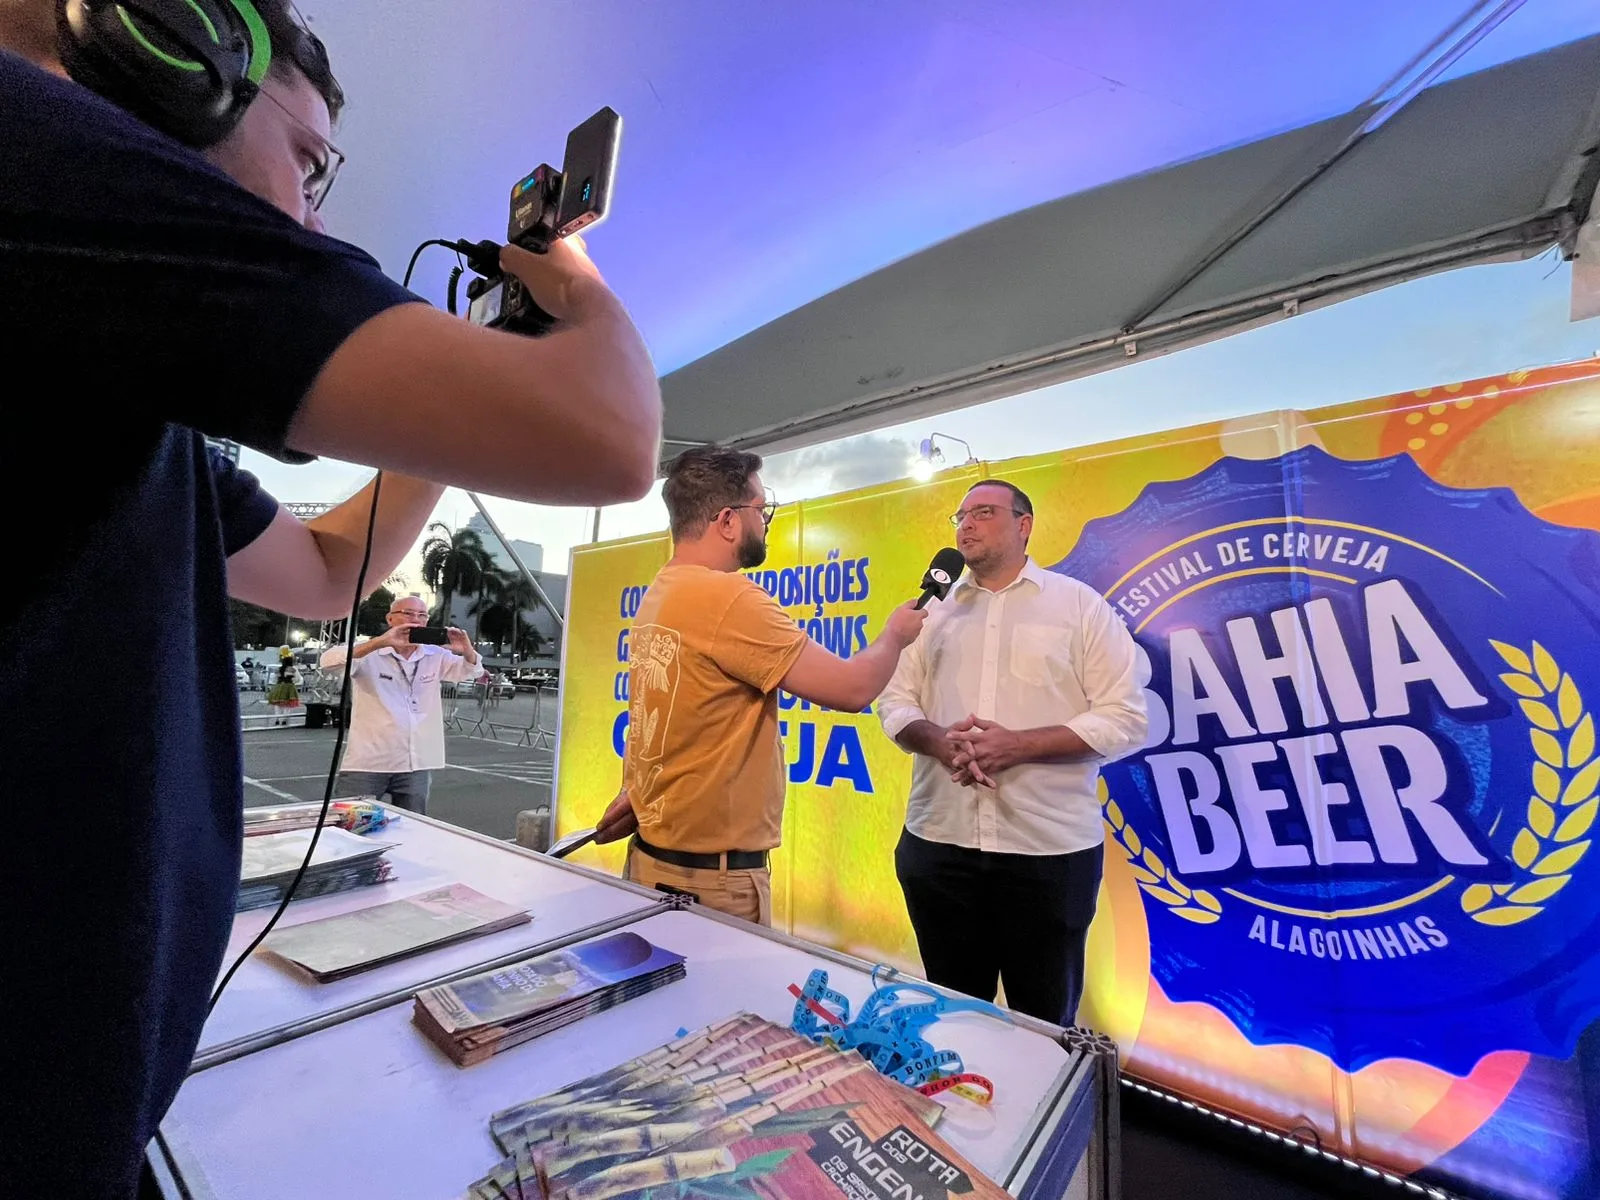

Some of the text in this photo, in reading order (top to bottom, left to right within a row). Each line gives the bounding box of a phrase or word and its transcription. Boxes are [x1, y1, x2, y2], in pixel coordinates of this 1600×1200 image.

[1216, 537, 1254, 566] DE
[1263, 532, 1389, 573] CERVEJA
[743, 549, 870, 617] POSIÇÕES
[1145, 725, 1489, 874] BEER
[1247, 904, 1449, 961] ALAGOINHAS
[904, 1052, 958, 1075] BONFIM
[881, 1141, 908, 1164] DOS
[889, 1129, 961, 1185] ROTA
